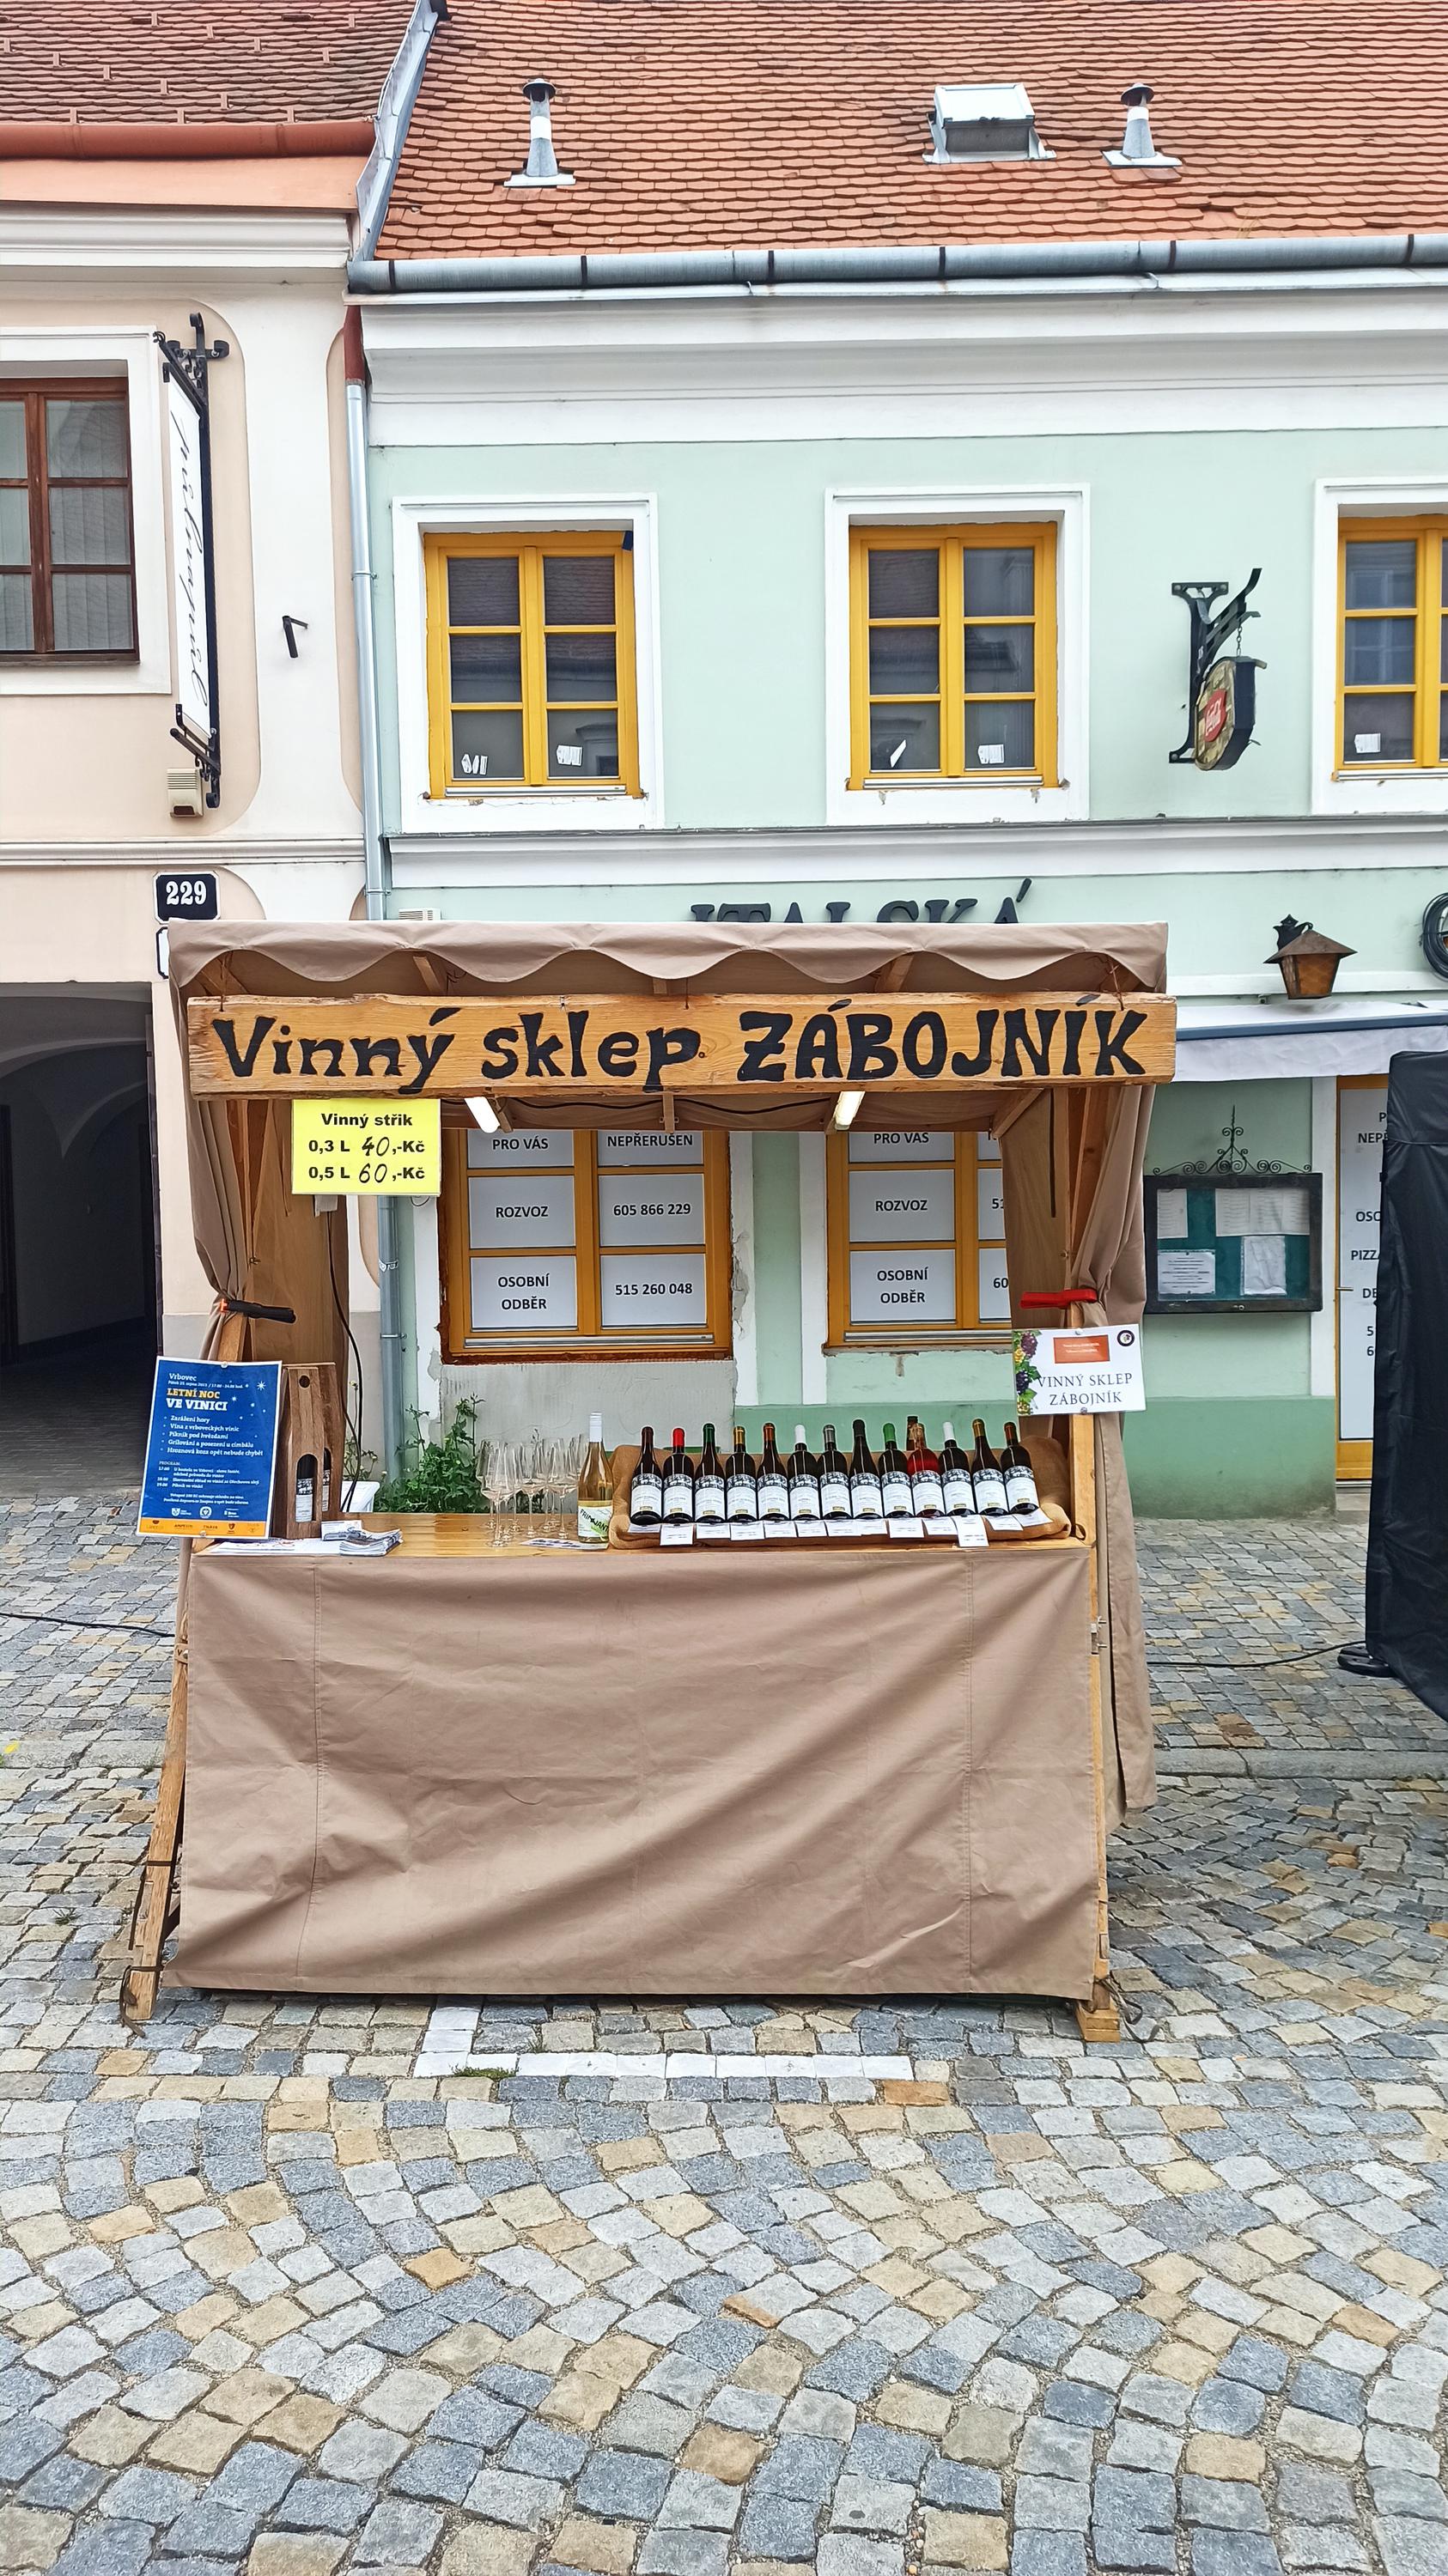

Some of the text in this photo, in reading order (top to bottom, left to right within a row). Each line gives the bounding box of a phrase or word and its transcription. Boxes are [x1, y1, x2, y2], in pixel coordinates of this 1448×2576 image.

[167, 881, 206, 904] 229
[211, 994, 1147, 1095] Vinný sklep ZÁBOJNÍK
[321, 1113, 412, 1128] Vinný střik
[493, 1136, 548, 1150] PRO VÁS
[874, 1133, 900, 1144] PRO
[309, 1140, 334, 1154] 0,3
[341, 1140, 350, 1151] L
[309, 1167, 334, 1181] 0,5
[341, 1167, 350, 1178] L
[496, 1206, 548, 1218] ROZVOZ
[613, 1204, 691, 1215] 605 866 229
[875, 1200, 928, 1211] ROZVOZ
[498, 1273, 550, 1287] OSOBNÍ
[877, 1267, 928, 1281] OSOBNÍ
[615, 1283, 692, 1295] 515 260 048
[502, 1296, 547, 1310] ODBĚR
[880, 1290, 925, 1303] ODBĚR
[1038, 1373, 1132, 1388] VINNÝ SKLEP
[167, 1388, 197, 1398] LETNÍ
[1049, 1390, 1123, 1406] ZÁBOJNÍK
[167, 1398, 228, 1411] VE VINICI
